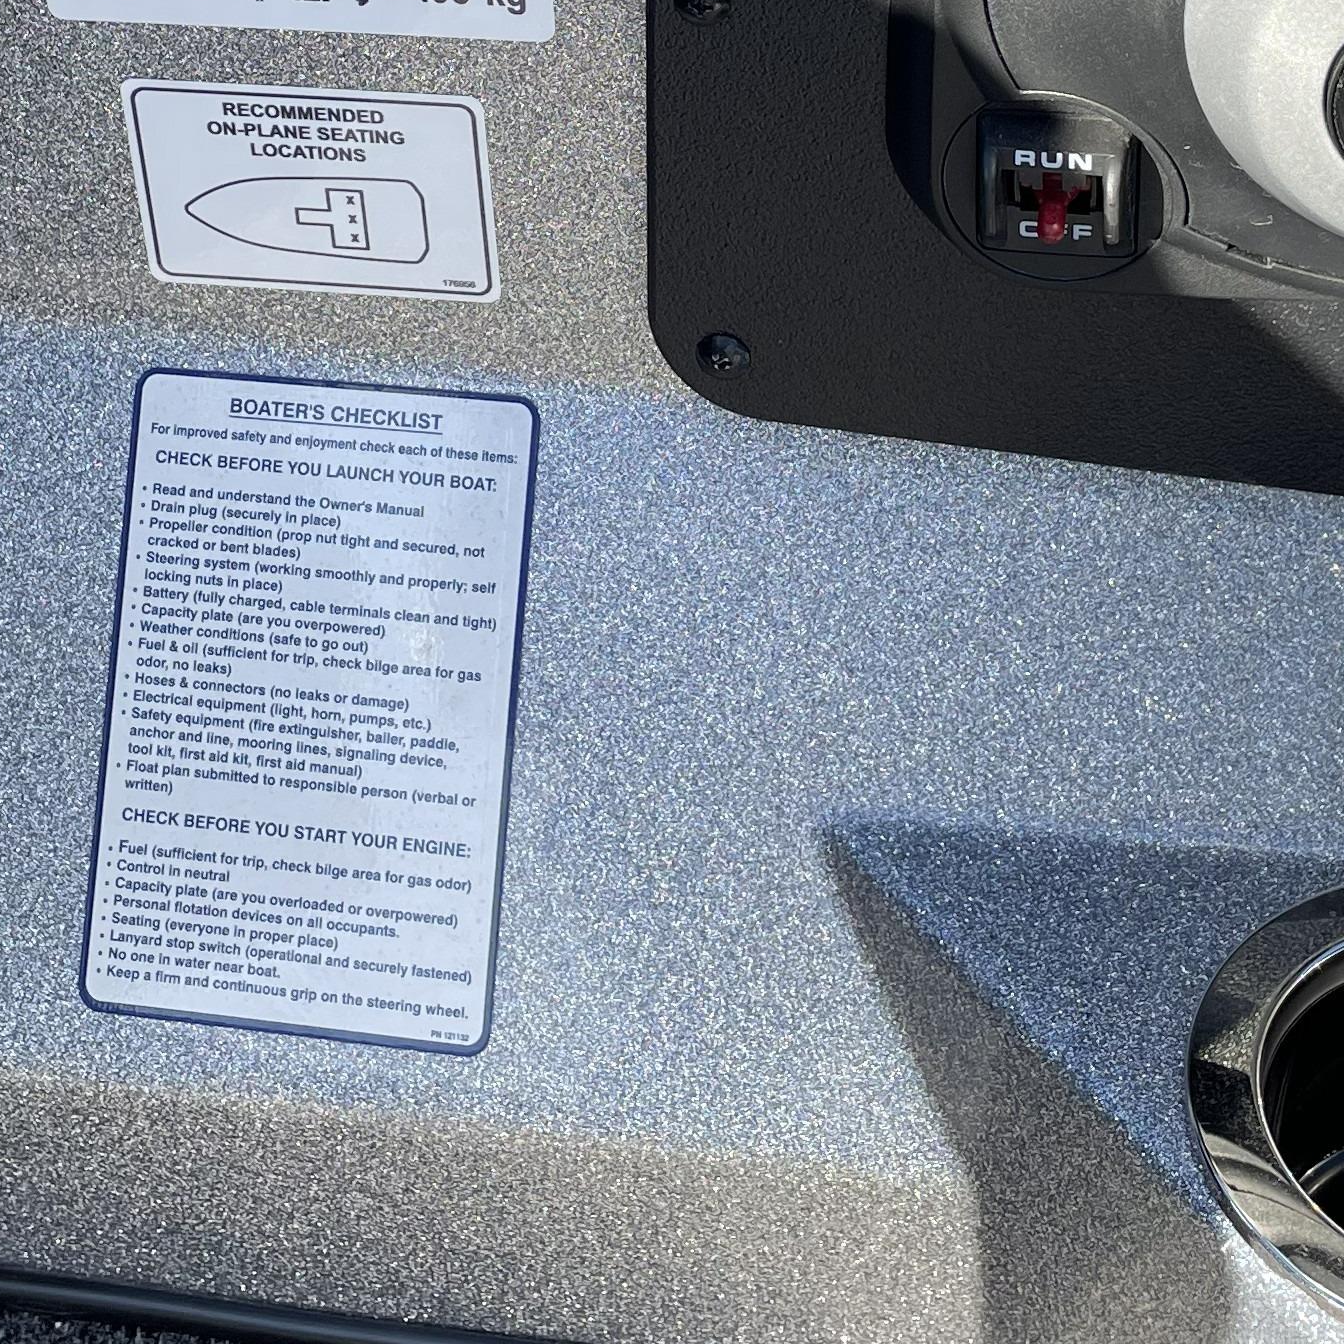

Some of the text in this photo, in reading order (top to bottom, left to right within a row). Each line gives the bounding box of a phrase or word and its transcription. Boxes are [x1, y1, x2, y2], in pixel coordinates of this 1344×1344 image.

[222, 102, 384, 124] RECOMMENDED
[207, 121, 405, 145] ON-PLANE SEATING
[250, 143, 366, 162] LOCATIONS
[1014, 149, 1092, 171] RUN
[1019, 221, 1092, 240] OF
[229, 397, 443, 430] BOATER'S CHECKLIST
[150, 421, 518, 464] For improved safety and enjoyment check each of these items:
[155, 449, 497, 492] CHECK BEFORE YOU LAUNCH YOUR BOAT:
[150, 499, 341, 531] Drain plug (securely in place)
[142, 585, 497, 632] Battery (fully charged, cable terminals clean and tight)
[136, 655, 232, 678] odor, no leaks)
[124, 778, 173, 796] written)
[121, 806, 471, 858] CHECK BEFORE YOU START YOUR ENGINE:
[114, 876, 458, 929] Capacity plate (are you overloaded or overpowered)
[108, 946, 280, 978] No one in water near boat.
